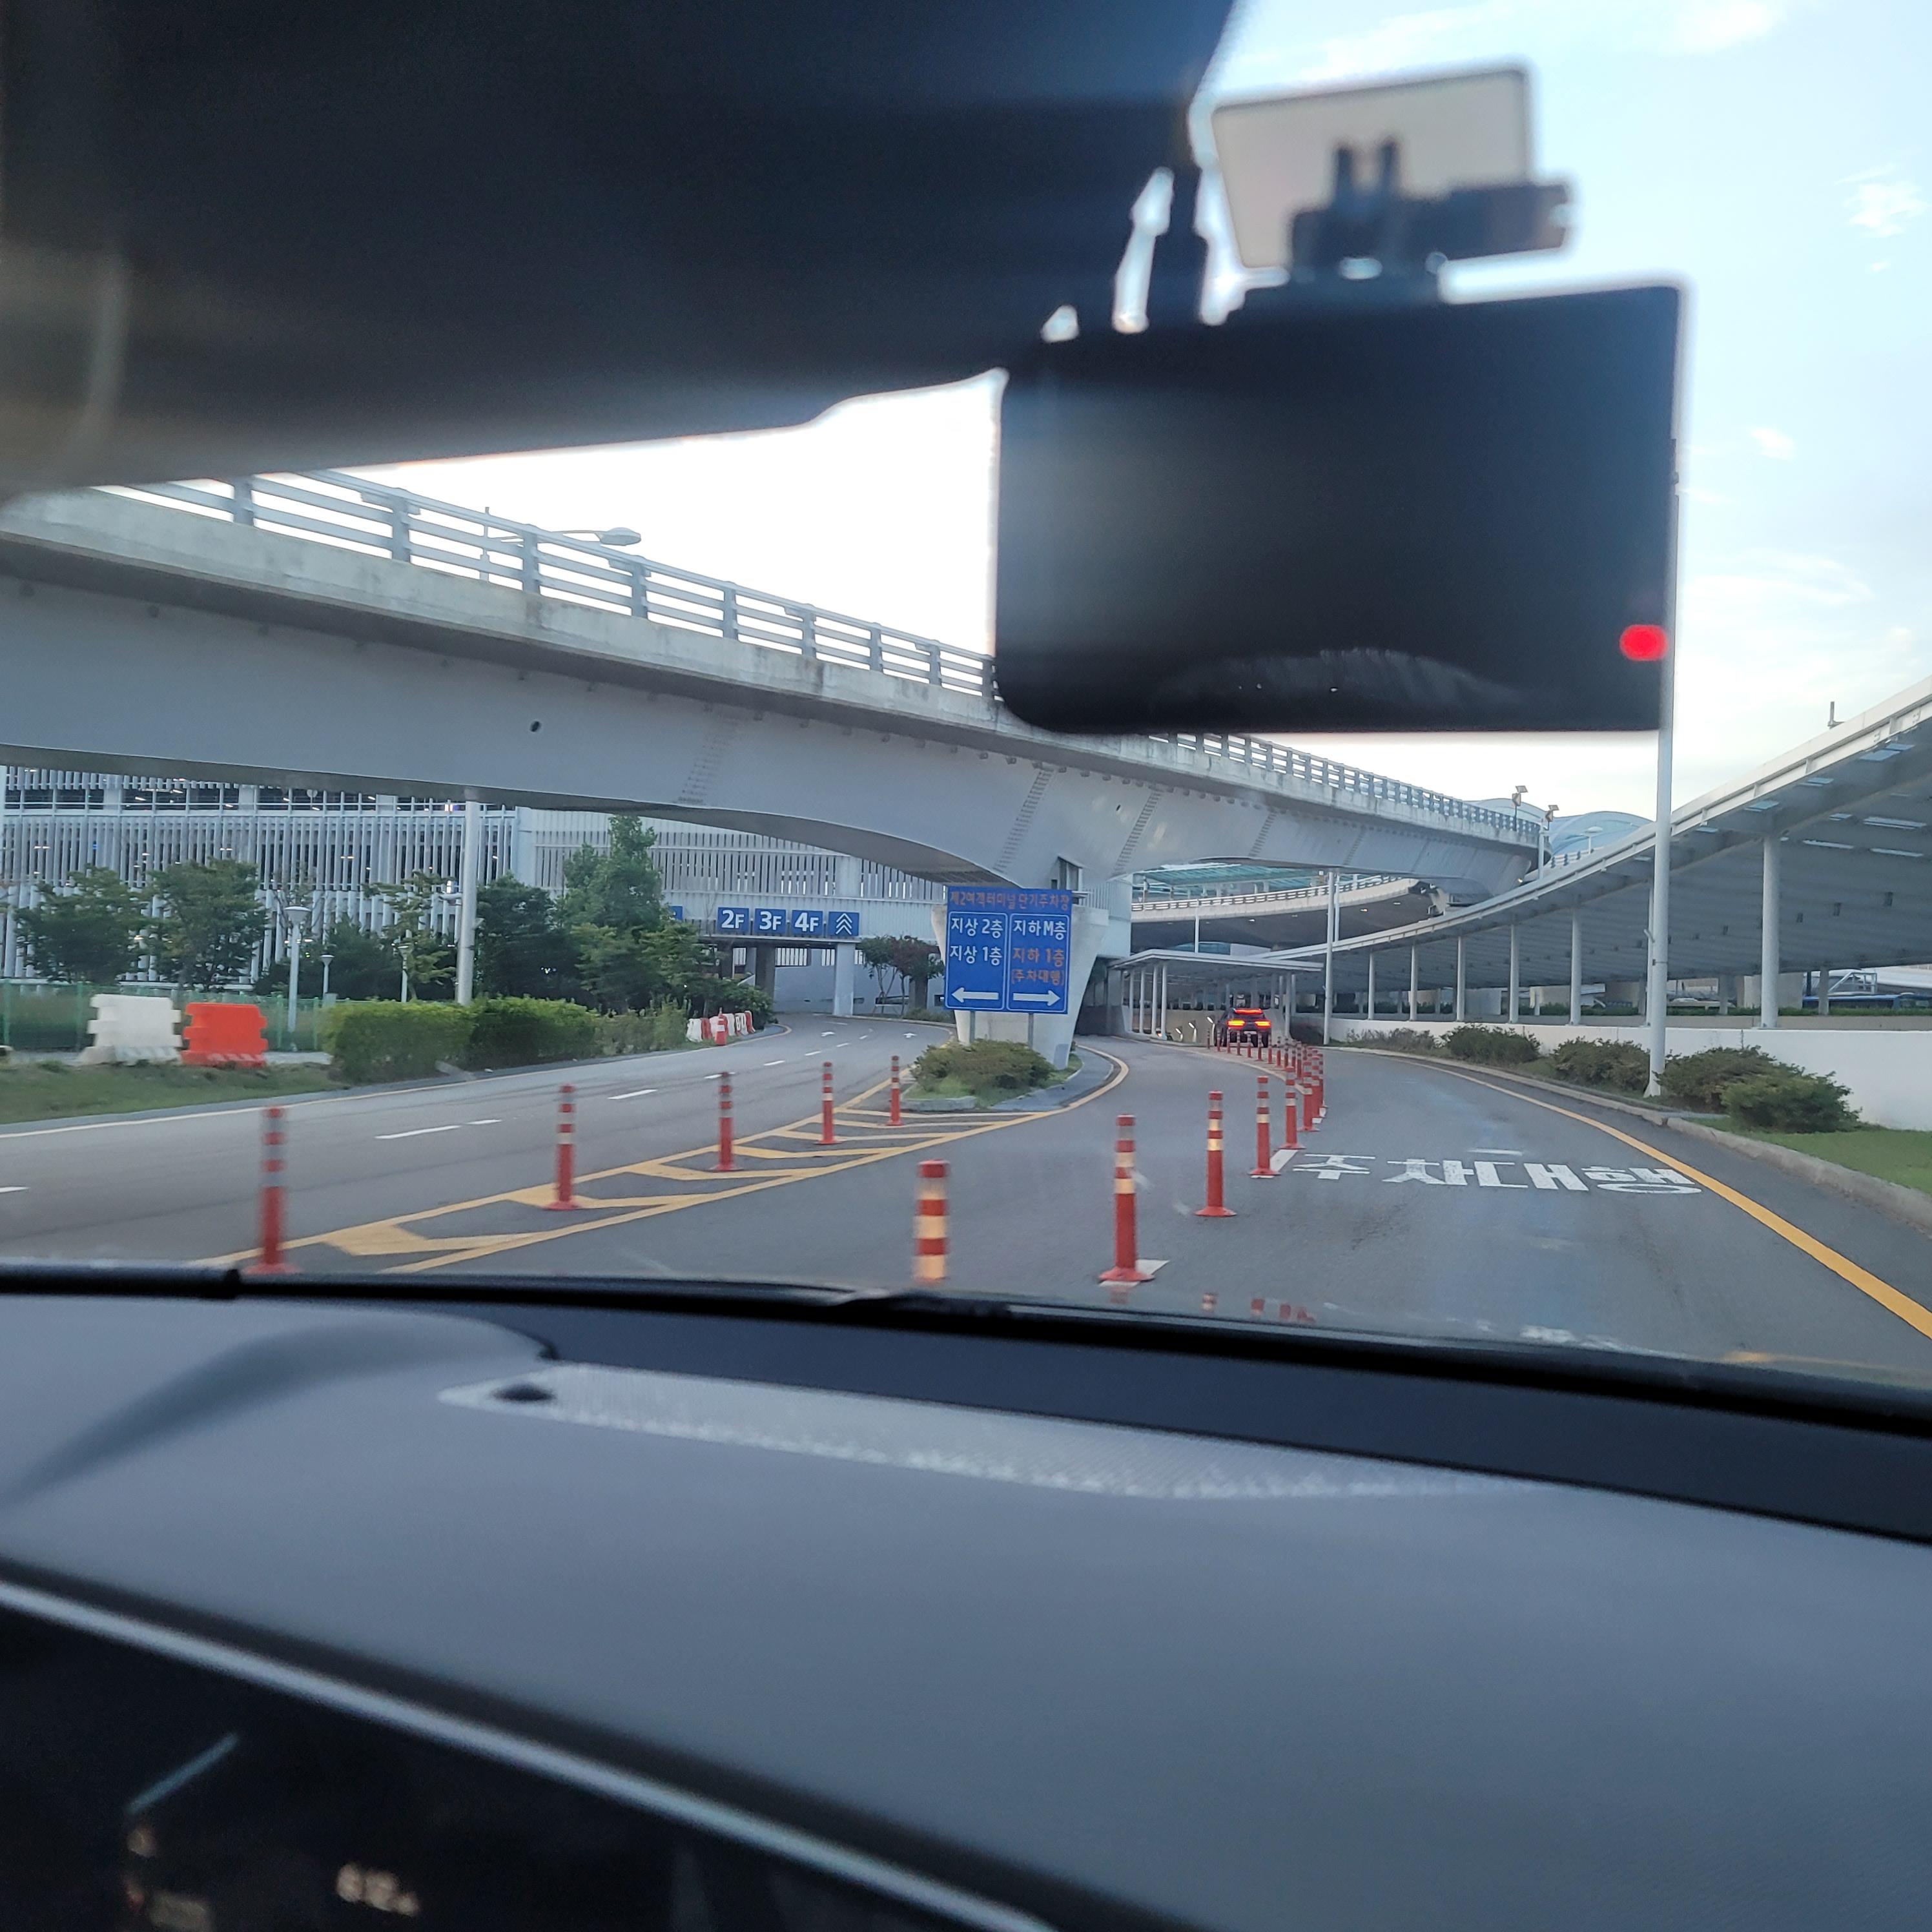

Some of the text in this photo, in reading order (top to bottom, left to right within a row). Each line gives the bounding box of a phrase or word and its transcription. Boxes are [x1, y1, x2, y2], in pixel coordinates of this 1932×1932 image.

[950, 890, 1069, 911] 제2여객터미널 단기주차장
[721, 910, 818, 932] 2F 3F 4F
[951, 918, 1003, 939] 지상 2층
[950, 945, 1003, 966] 지상 1층
[1012, 948, 1065, 967] 지하 1층
[1293, 1153, 1701, 1193] 주차대행
